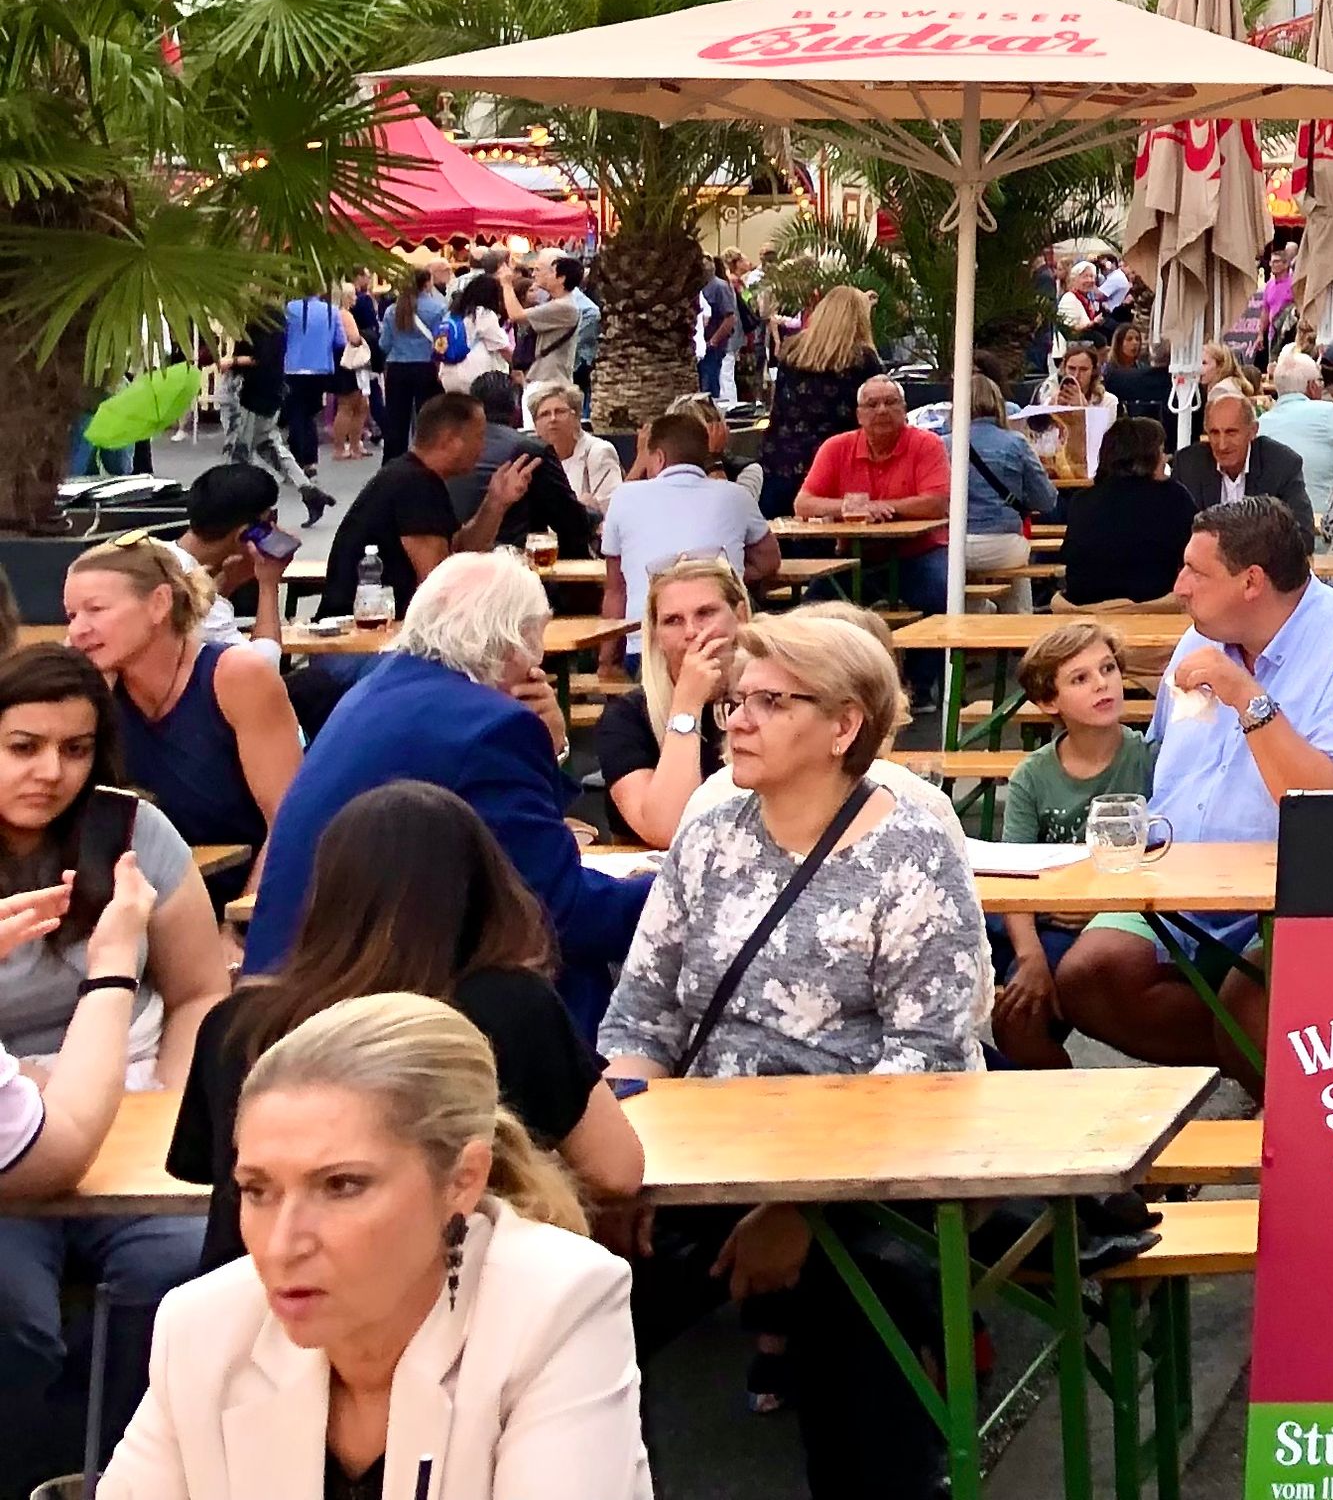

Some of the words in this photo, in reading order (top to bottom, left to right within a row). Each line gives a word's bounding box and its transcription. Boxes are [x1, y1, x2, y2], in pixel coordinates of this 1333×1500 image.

[791, 9, 1082, 22] BUDWEISER
[697, 23, 1107, 66] Budvar
[1271, 1484, 1315, 1499] vom
